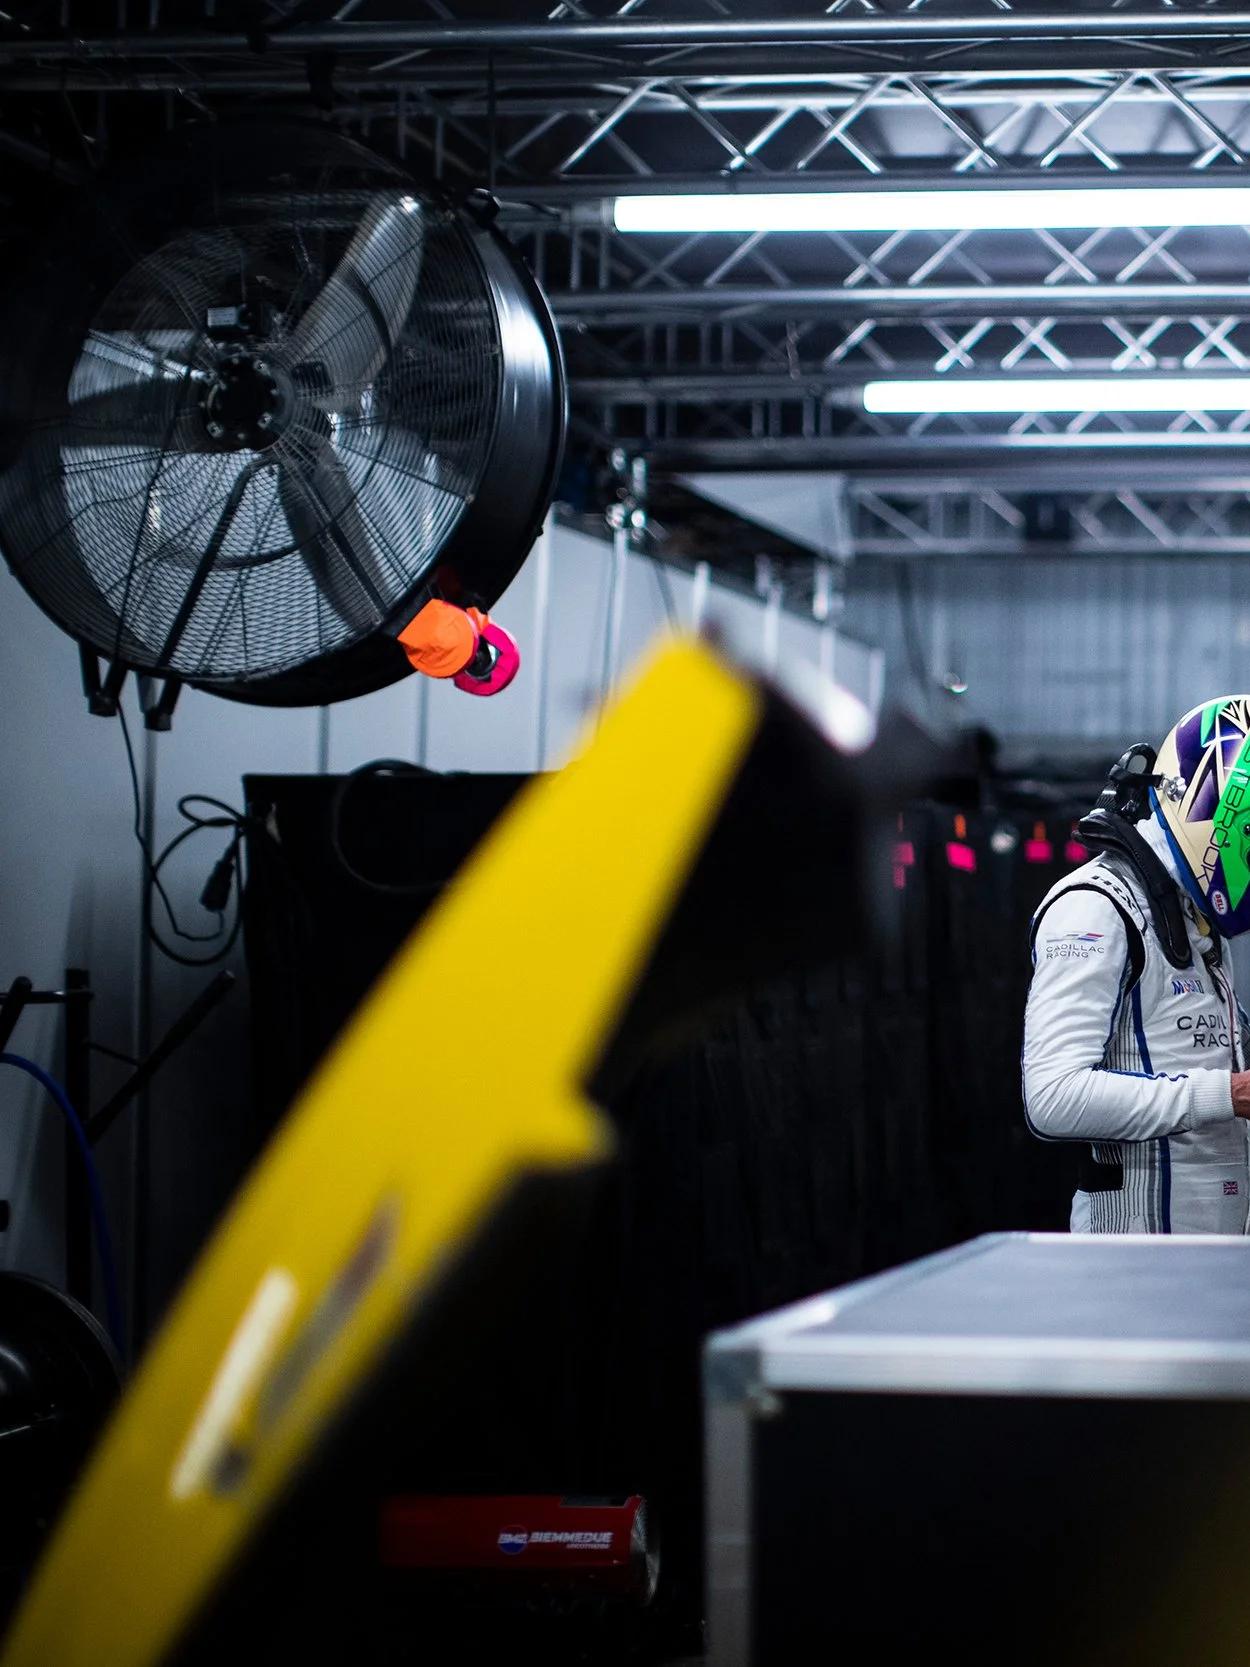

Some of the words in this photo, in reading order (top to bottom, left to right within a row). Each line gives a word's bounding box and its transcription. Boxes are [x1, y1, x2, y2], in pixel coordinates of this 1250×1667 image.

[1046, 943, 1105, 954] CADILLAC
[1046, 950, 1089, 959] RACING
[528, 1531, 614, 1543] BIEMMEDUE
